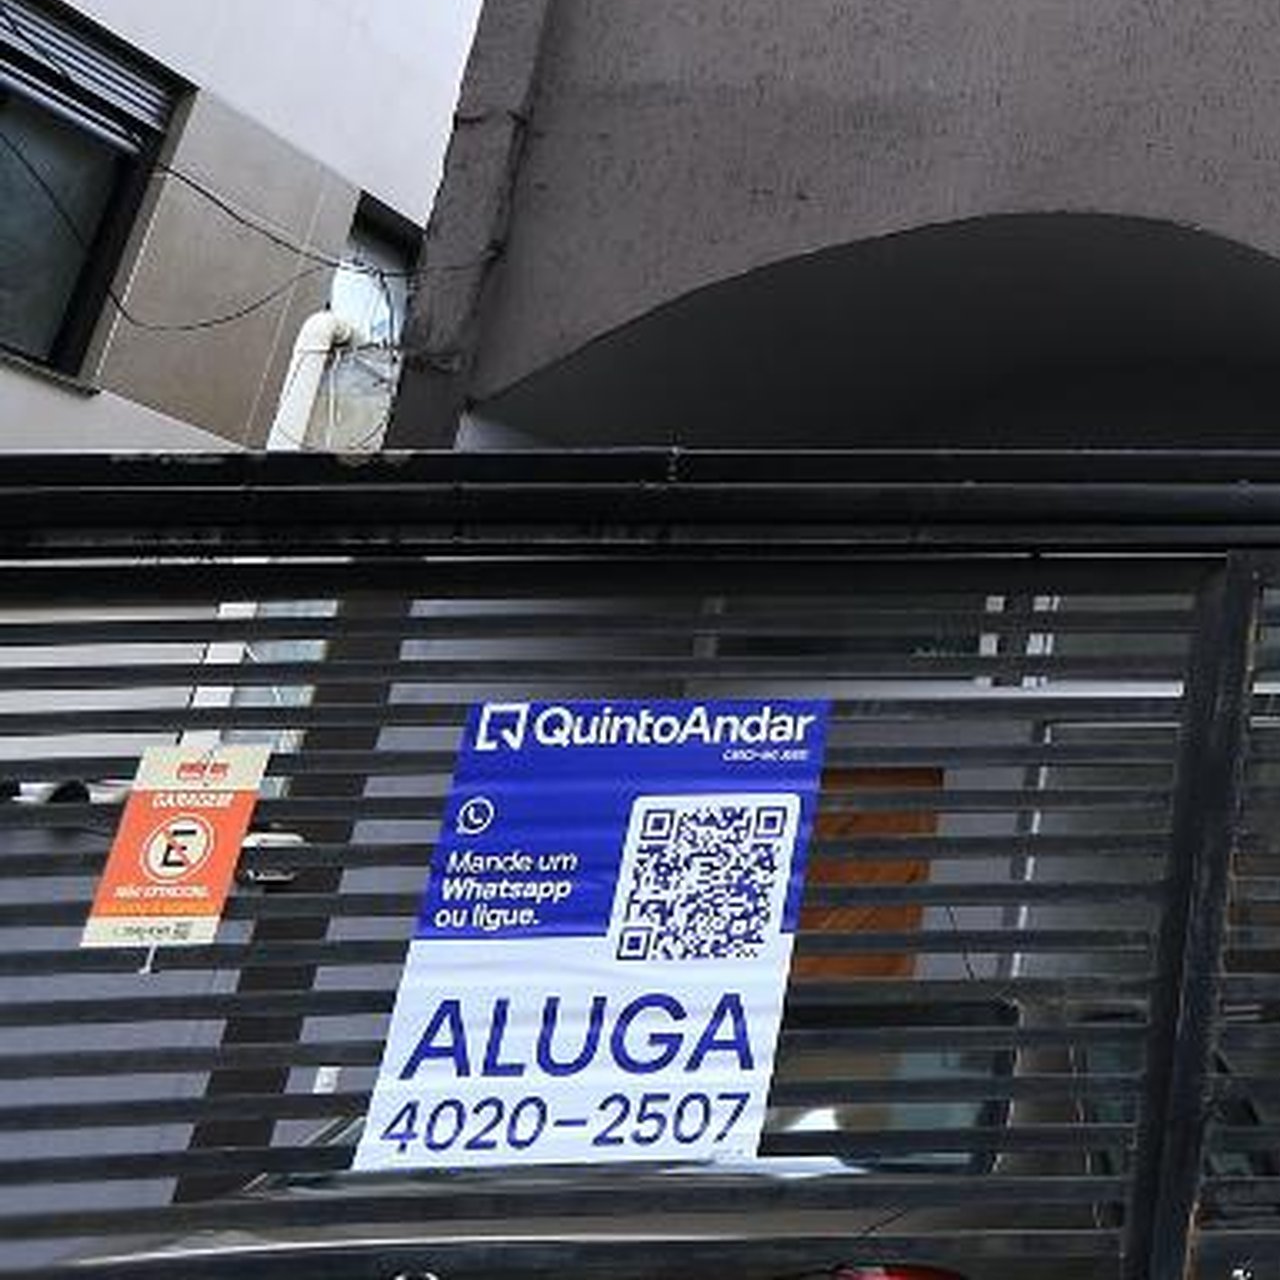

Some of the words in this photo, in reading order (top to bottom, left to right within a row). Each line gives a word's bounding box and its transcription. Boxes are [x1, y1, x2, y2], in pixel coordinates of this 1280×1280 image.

[535, 705, 816, 746] QuintoAndar
[446, 850, 533, 873] Mande
[538, 853, 577, 871] um
[442, 878, 571, 904] Whatsapp
[435, 909, 467, 927] ou
[472, 903, 540, 931] ligue.
[401, 993, 754, 1080] ALUGA
[381, 1092, 750, 1153] 4020-2507
